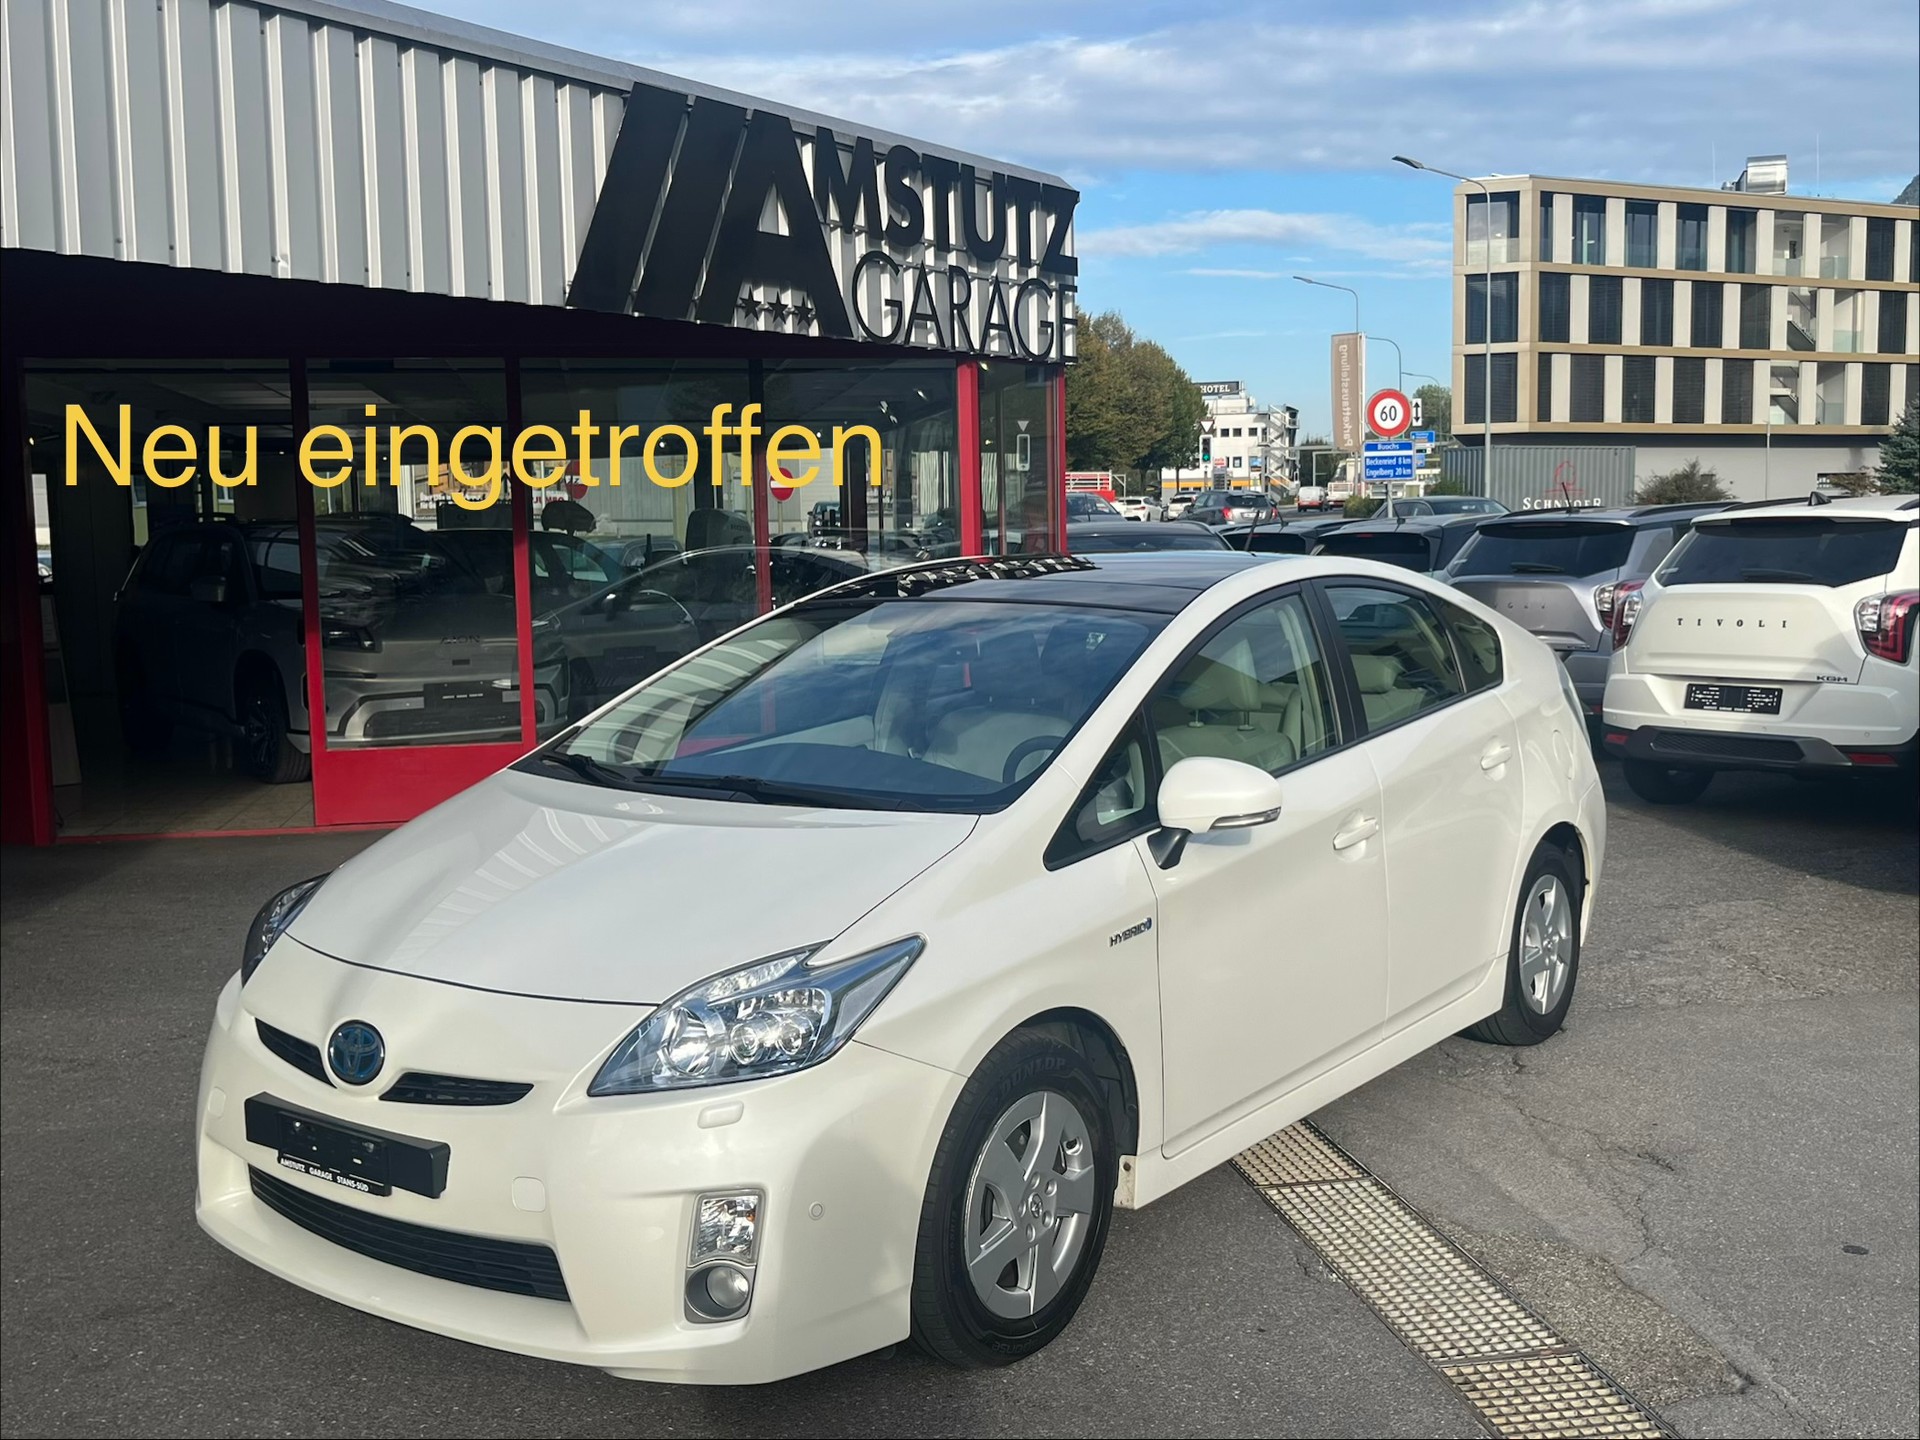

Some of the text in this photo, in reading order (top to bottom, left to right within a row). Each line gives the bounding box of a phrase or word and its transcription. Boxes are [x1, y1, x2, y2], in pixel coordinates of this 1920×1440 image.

[695, 108, 1079, 338] AMSTUTZ
[852, 250, 1079, 363] GARAGE
[1380, 405, 1397, 422] 60
[1366, 457, 1397, 466] Beckenried
[1403, 457, 1412, 465] km
[1366, 467, 1412, 478] Engelberg 20 km
[1677, 617, 1788, 629] TIVOLI
[1816, 674, 1848, 683] KGM
[1109, 922, 1147, 948] HYBRID
[280, 1158, 369, 1192] AMSTUTZ GARAGE STANS-SÜD
